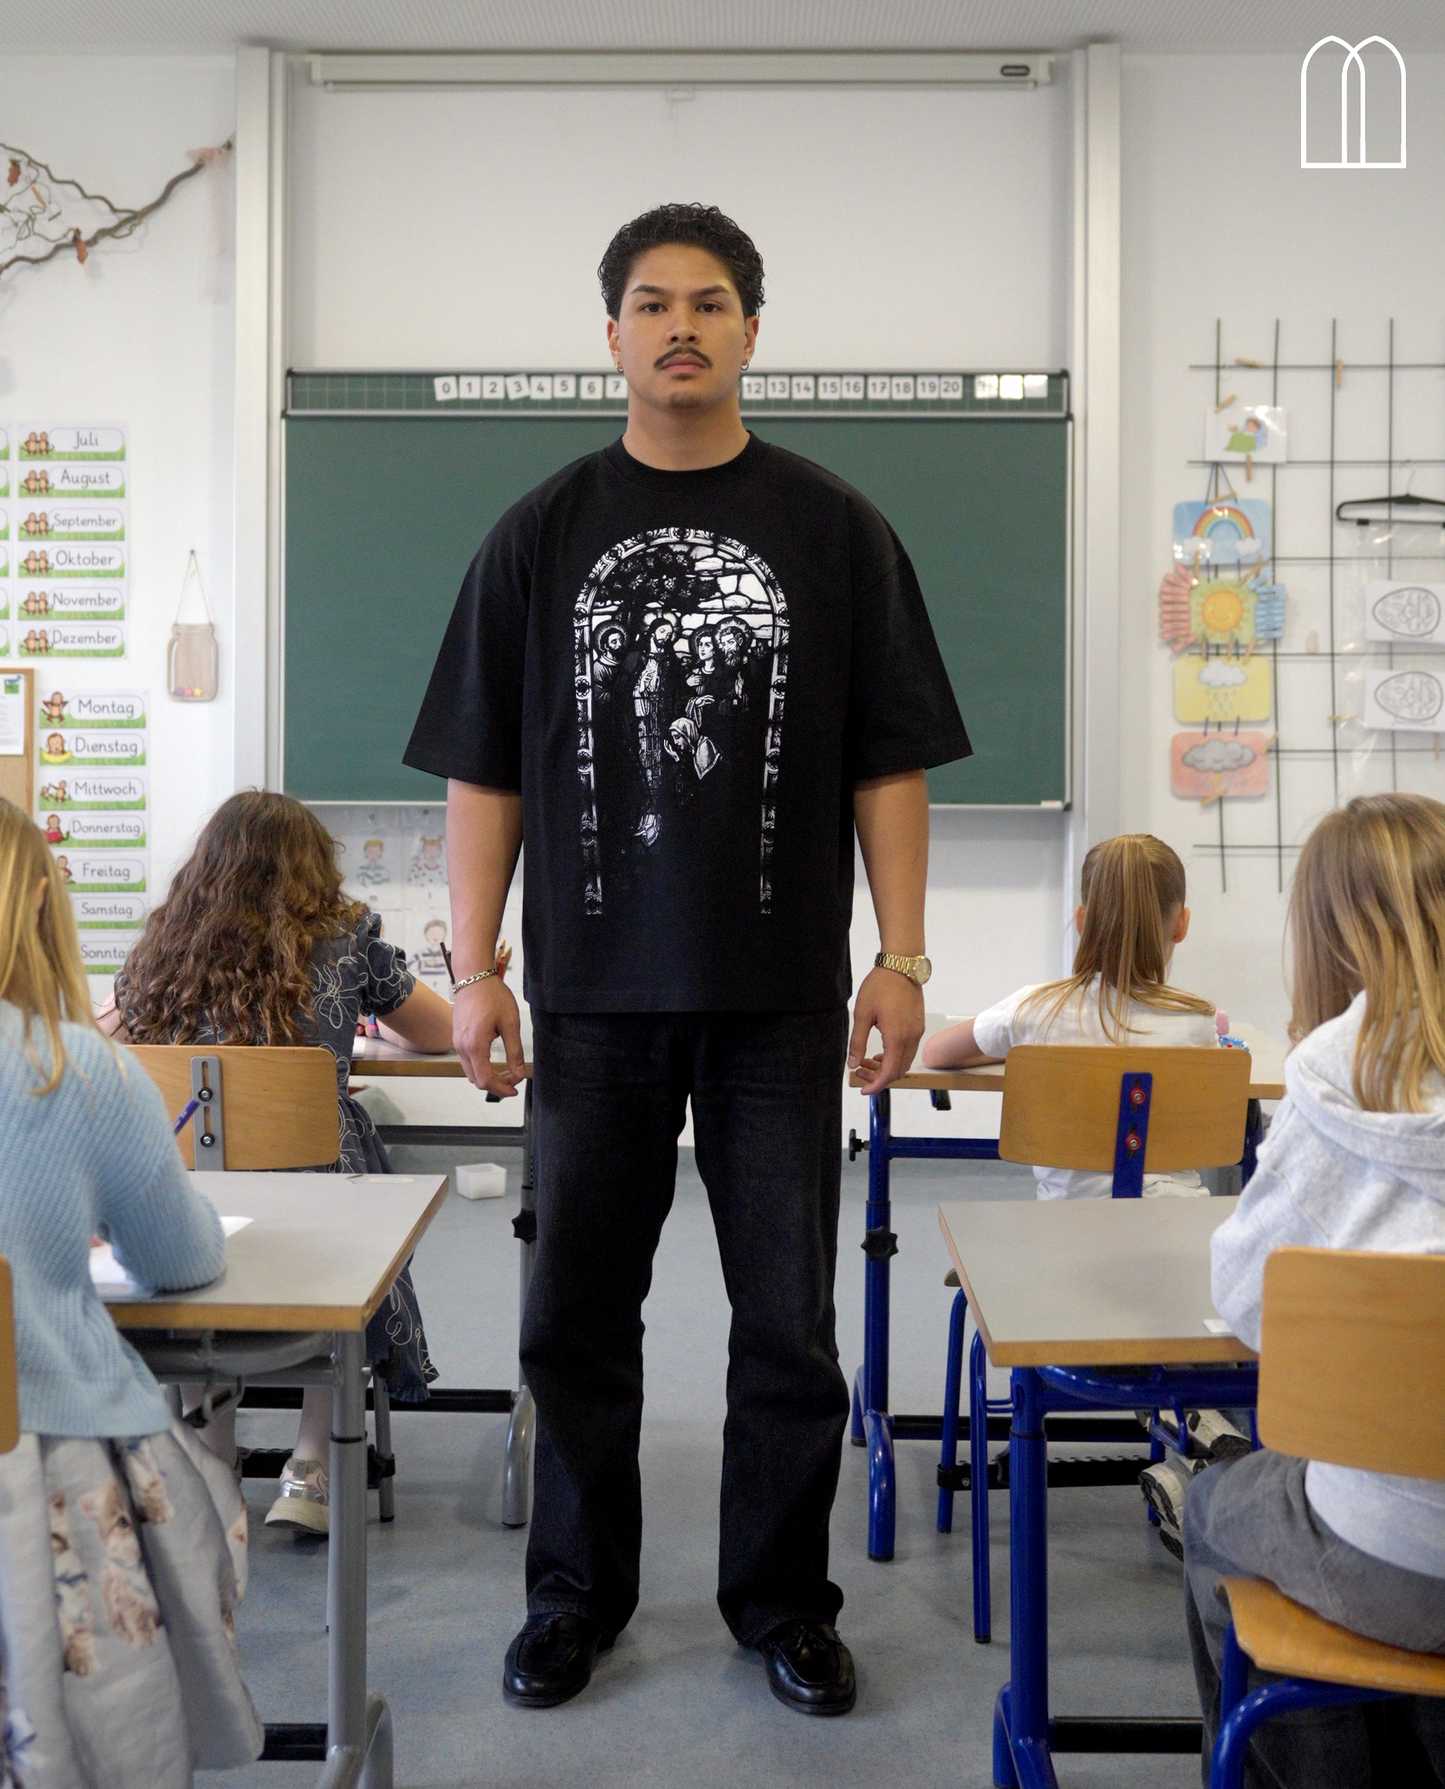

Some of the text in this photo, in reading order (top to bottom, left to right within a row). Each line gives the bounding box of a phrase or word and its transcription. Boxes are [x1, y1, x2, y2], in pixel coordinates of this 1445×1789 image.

[442, 380, 959, 394] 0 1 2 3 4 5 6 7 12 13 14 15 16 17 18 19 20
[73, 431, 98, 449] Juli
[61, 469, 110, 489] August
[54, 514, 117, 530] September
[56, 550, 114, 566] Oktober
[53, 593, 118, 607] November
[53, 629, 117, 645] Dezember
[79, 699, 134, 718] Montag
[75, 737, 138, 756] Dienstag
[75, 782, 136, 795] Mittwoch
[72, 820, 140, 836] Donnerstag
[83, 863, 130, 880] Freitag
[81, 902, 133, 918] Samstag
[80, 944, 126, 959] Sonnta
